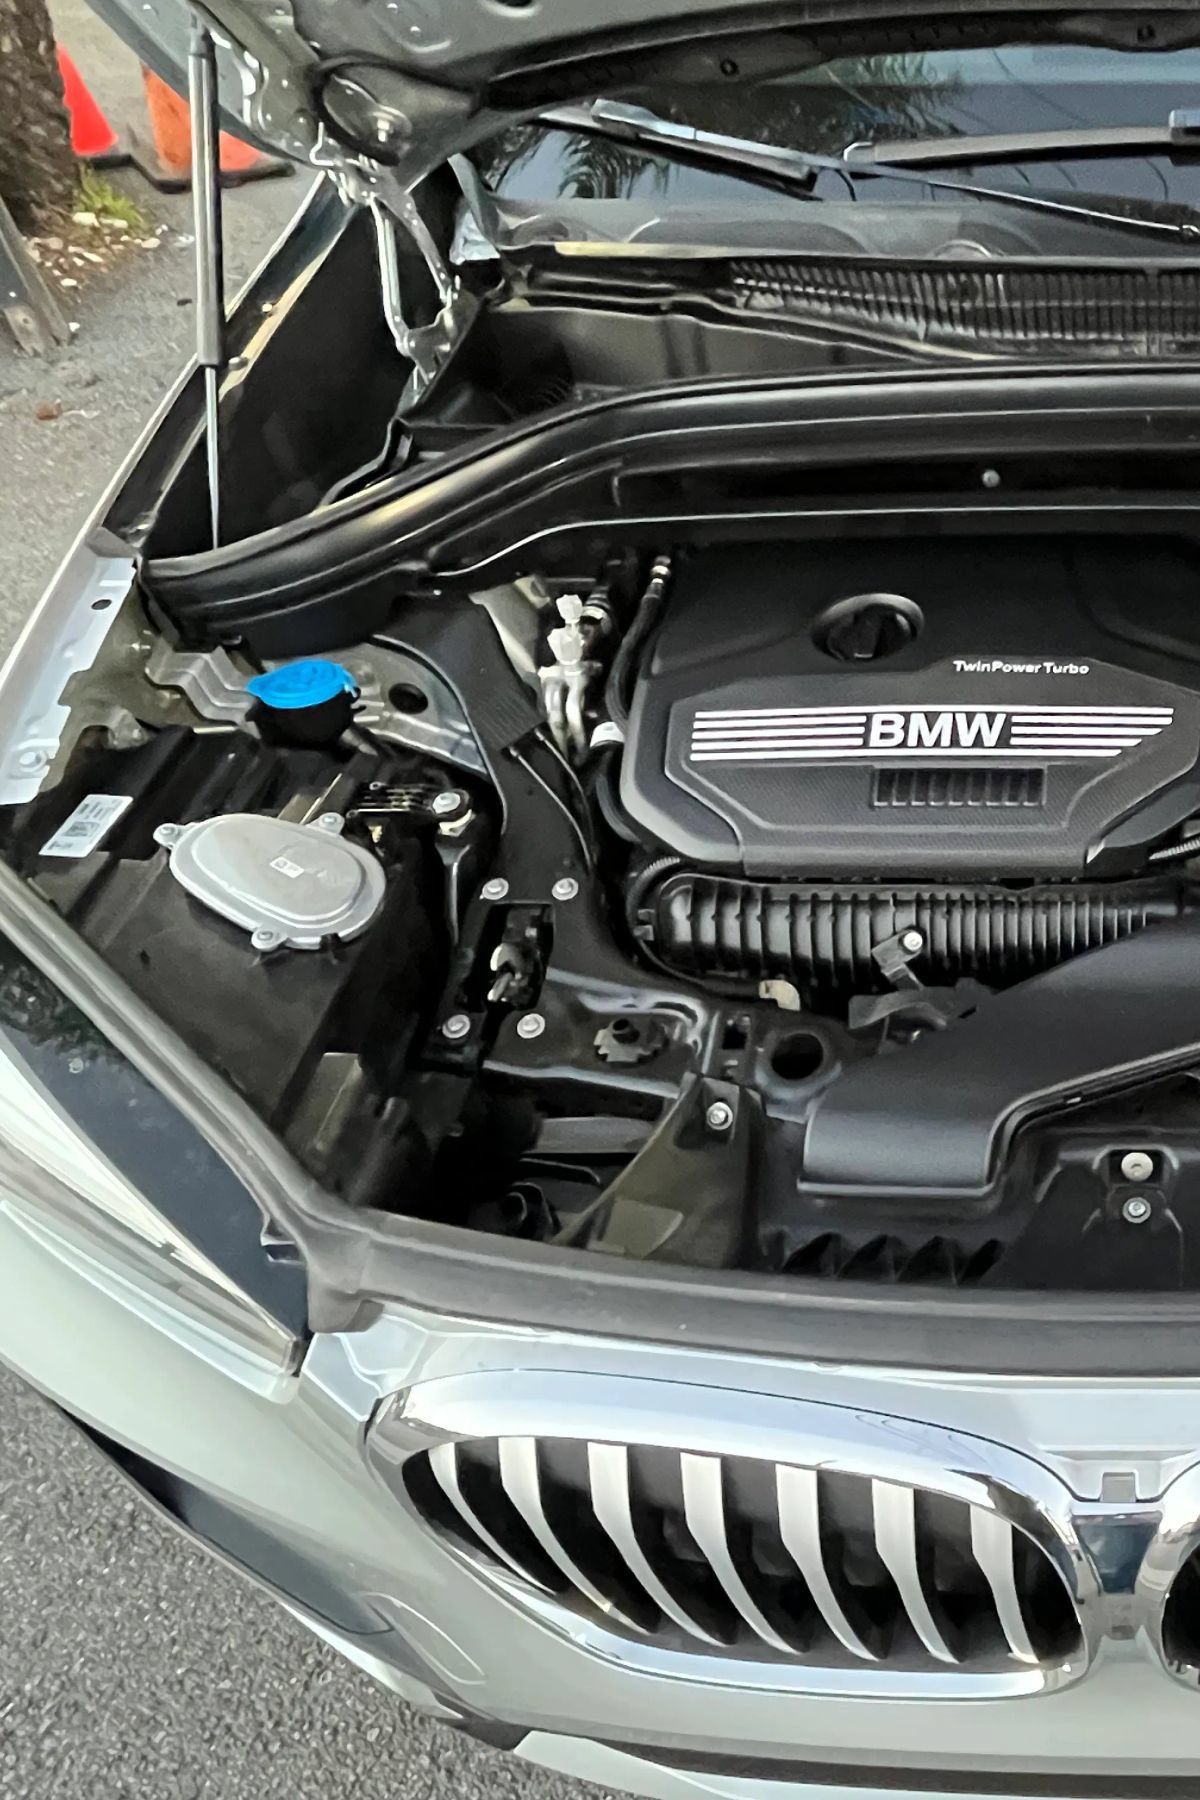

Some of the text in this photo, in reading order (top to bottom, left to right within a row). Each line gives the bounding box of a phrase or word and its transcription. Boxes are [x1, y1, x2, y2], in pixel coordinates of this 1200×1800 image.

[953, 660, 1089, 674] TwinPower Turbo
[868, 712, 1007, 748] BMW
